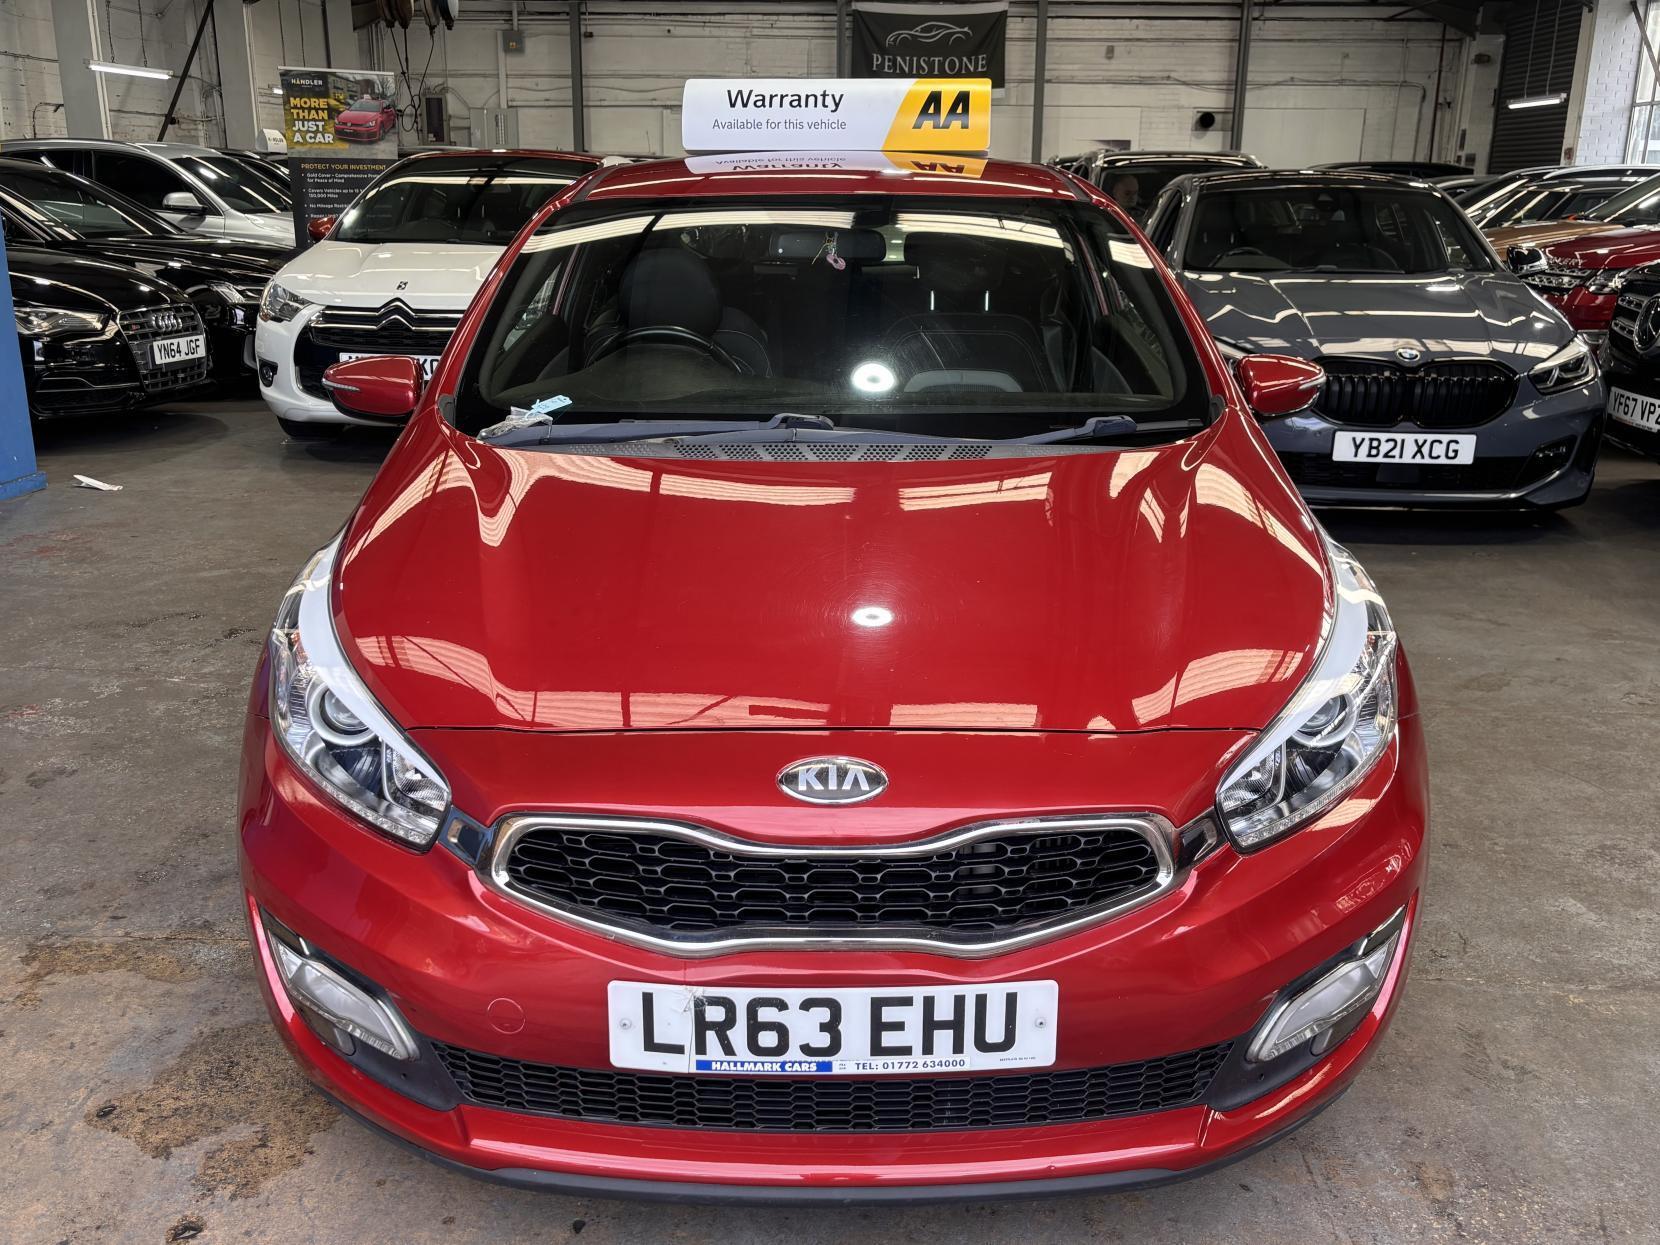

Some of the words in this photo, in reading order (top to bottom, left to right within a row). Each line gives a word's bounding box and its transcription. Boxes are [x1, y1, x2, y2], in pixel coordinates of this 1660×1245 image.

[872, 53, 988, 75] PENISTONE
[290, 97, 328, 108] MORE
[727, 88, 844, 113] Warranty
[912, 90, 969, 129] AA
[291, 109, 328, 120] THAN
[712, 118, 763, 130] Available
[766, 118, 783, 130] for
[785, 118, 804, 130] this
[807, 118, 847, 130] vehicle
[293, 120, 325, 132] JUST
[293, 132, 303, 143] A
[306, 132, 334, 143] CAR
[157, 342, 182, 360] YN64
[184, 338, 200, 356] JGF
[1613, 391, 1638, 418] YF67
[1352, 436, 1405, 459] YB21
[1411, 438, 1460, 461] XCG
[798, 765, 870, 791] KIA
[640, 991, 843, 1057] LR63
[869, 991, 1019, 1057] EHU
[711, 1061, 782, 1072] HALLMARK
[784, 1061, 818, 1072] CARS
[855, 1061, 879, 1071] TEL:
[882, 1061, 919, 1070] 01772
[922, 1059, 966, 1069] 634000
